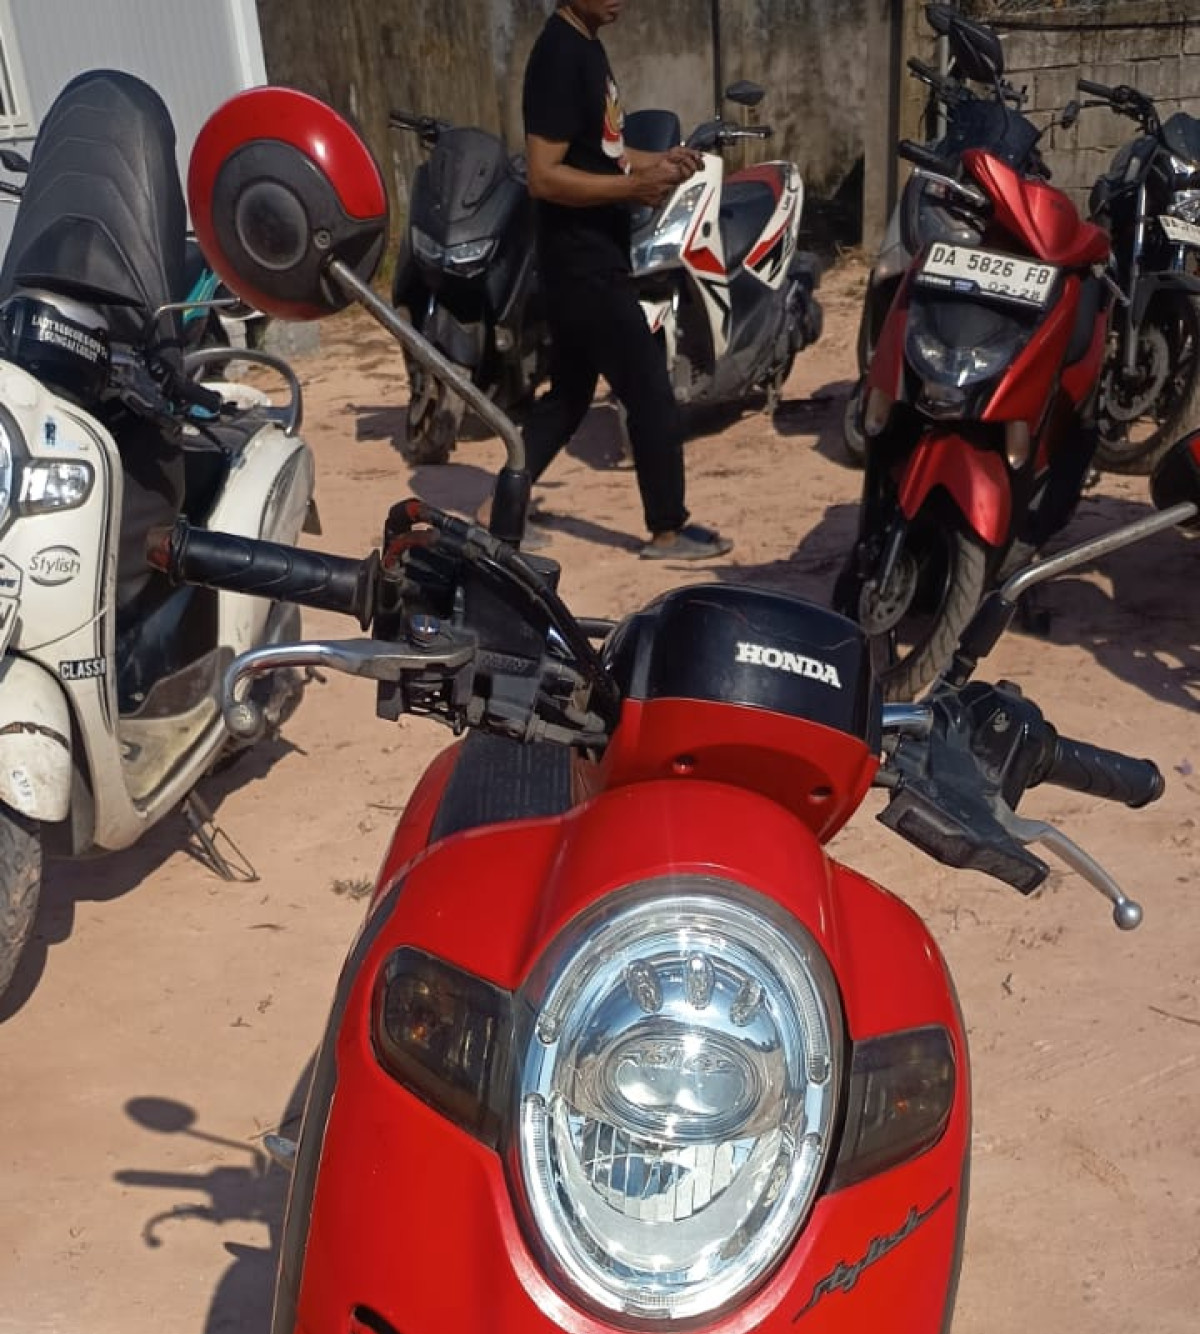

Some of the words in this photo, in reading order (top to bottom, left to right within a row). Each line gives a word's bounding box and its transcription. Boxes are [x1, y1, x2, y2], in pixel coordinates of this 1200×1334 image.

[932, 247, 956, 265] DA
[967, 254, 1014, 277] 5826
[1024, 266, 1050, 285] FB
[29, 555, 80, 575] Stylish
[735, 641, 841, 690] HONDA
